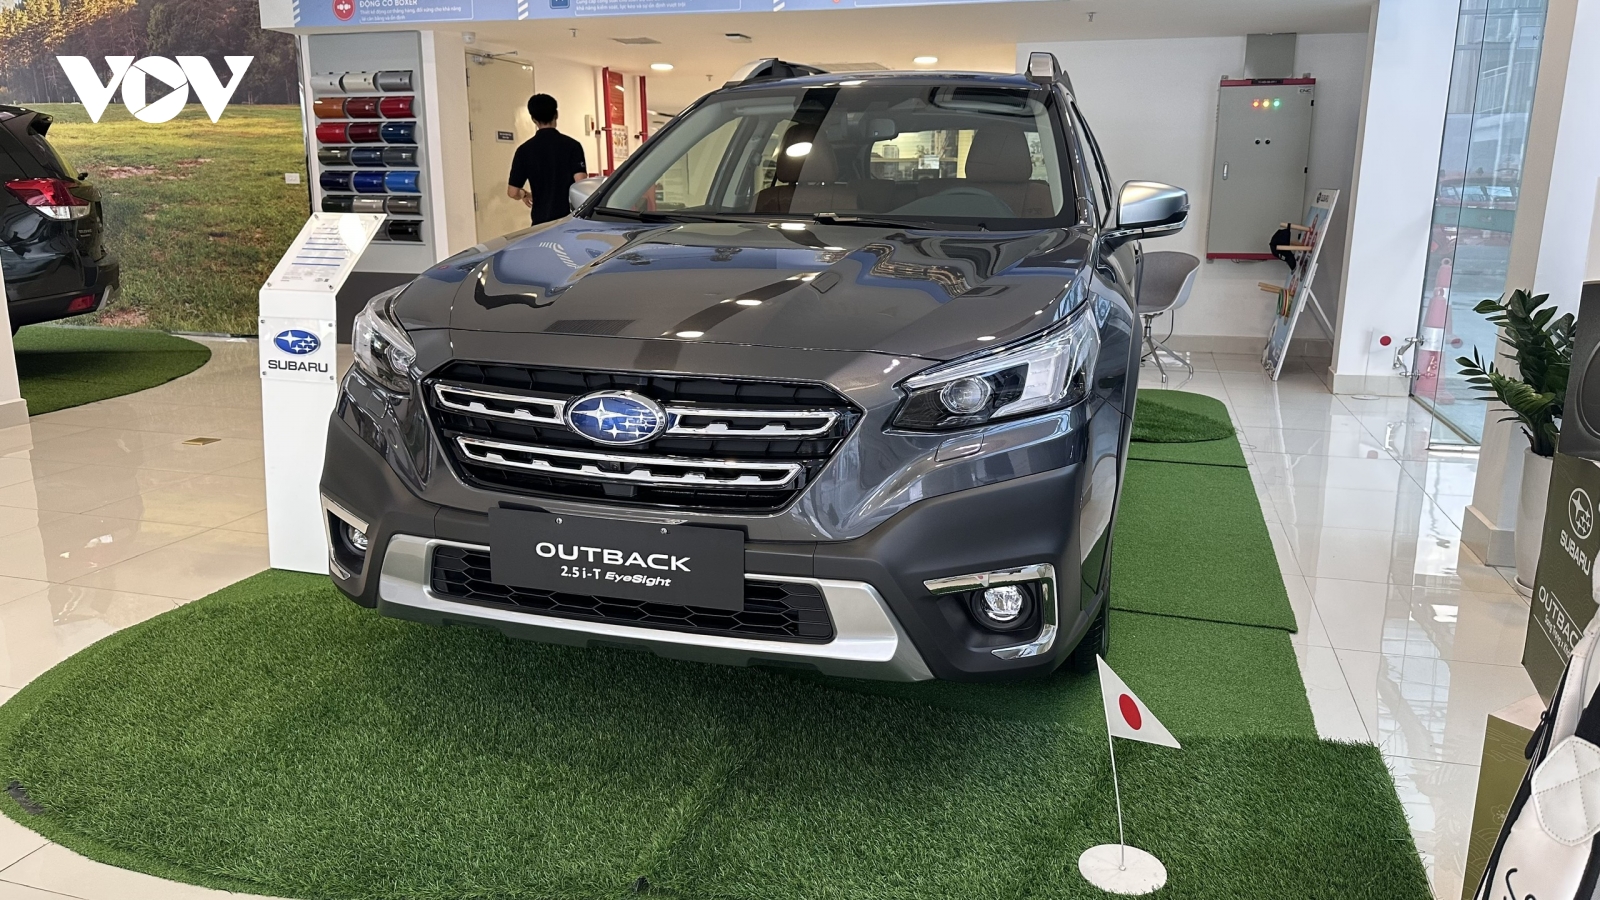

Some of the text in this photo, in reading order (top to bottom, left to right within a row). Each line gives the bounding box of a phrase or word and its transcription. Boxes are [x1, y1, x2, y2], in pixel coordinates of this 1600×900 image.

[268, 359, 328, 373] SUBARU
[535, 542, 691, 572] OUTBACK
[1559, 529, 1591, 576] SUBARU
[605, 571, 672, 588] EyeSight
[1538, 586, 1580, 649] OUTBAC
